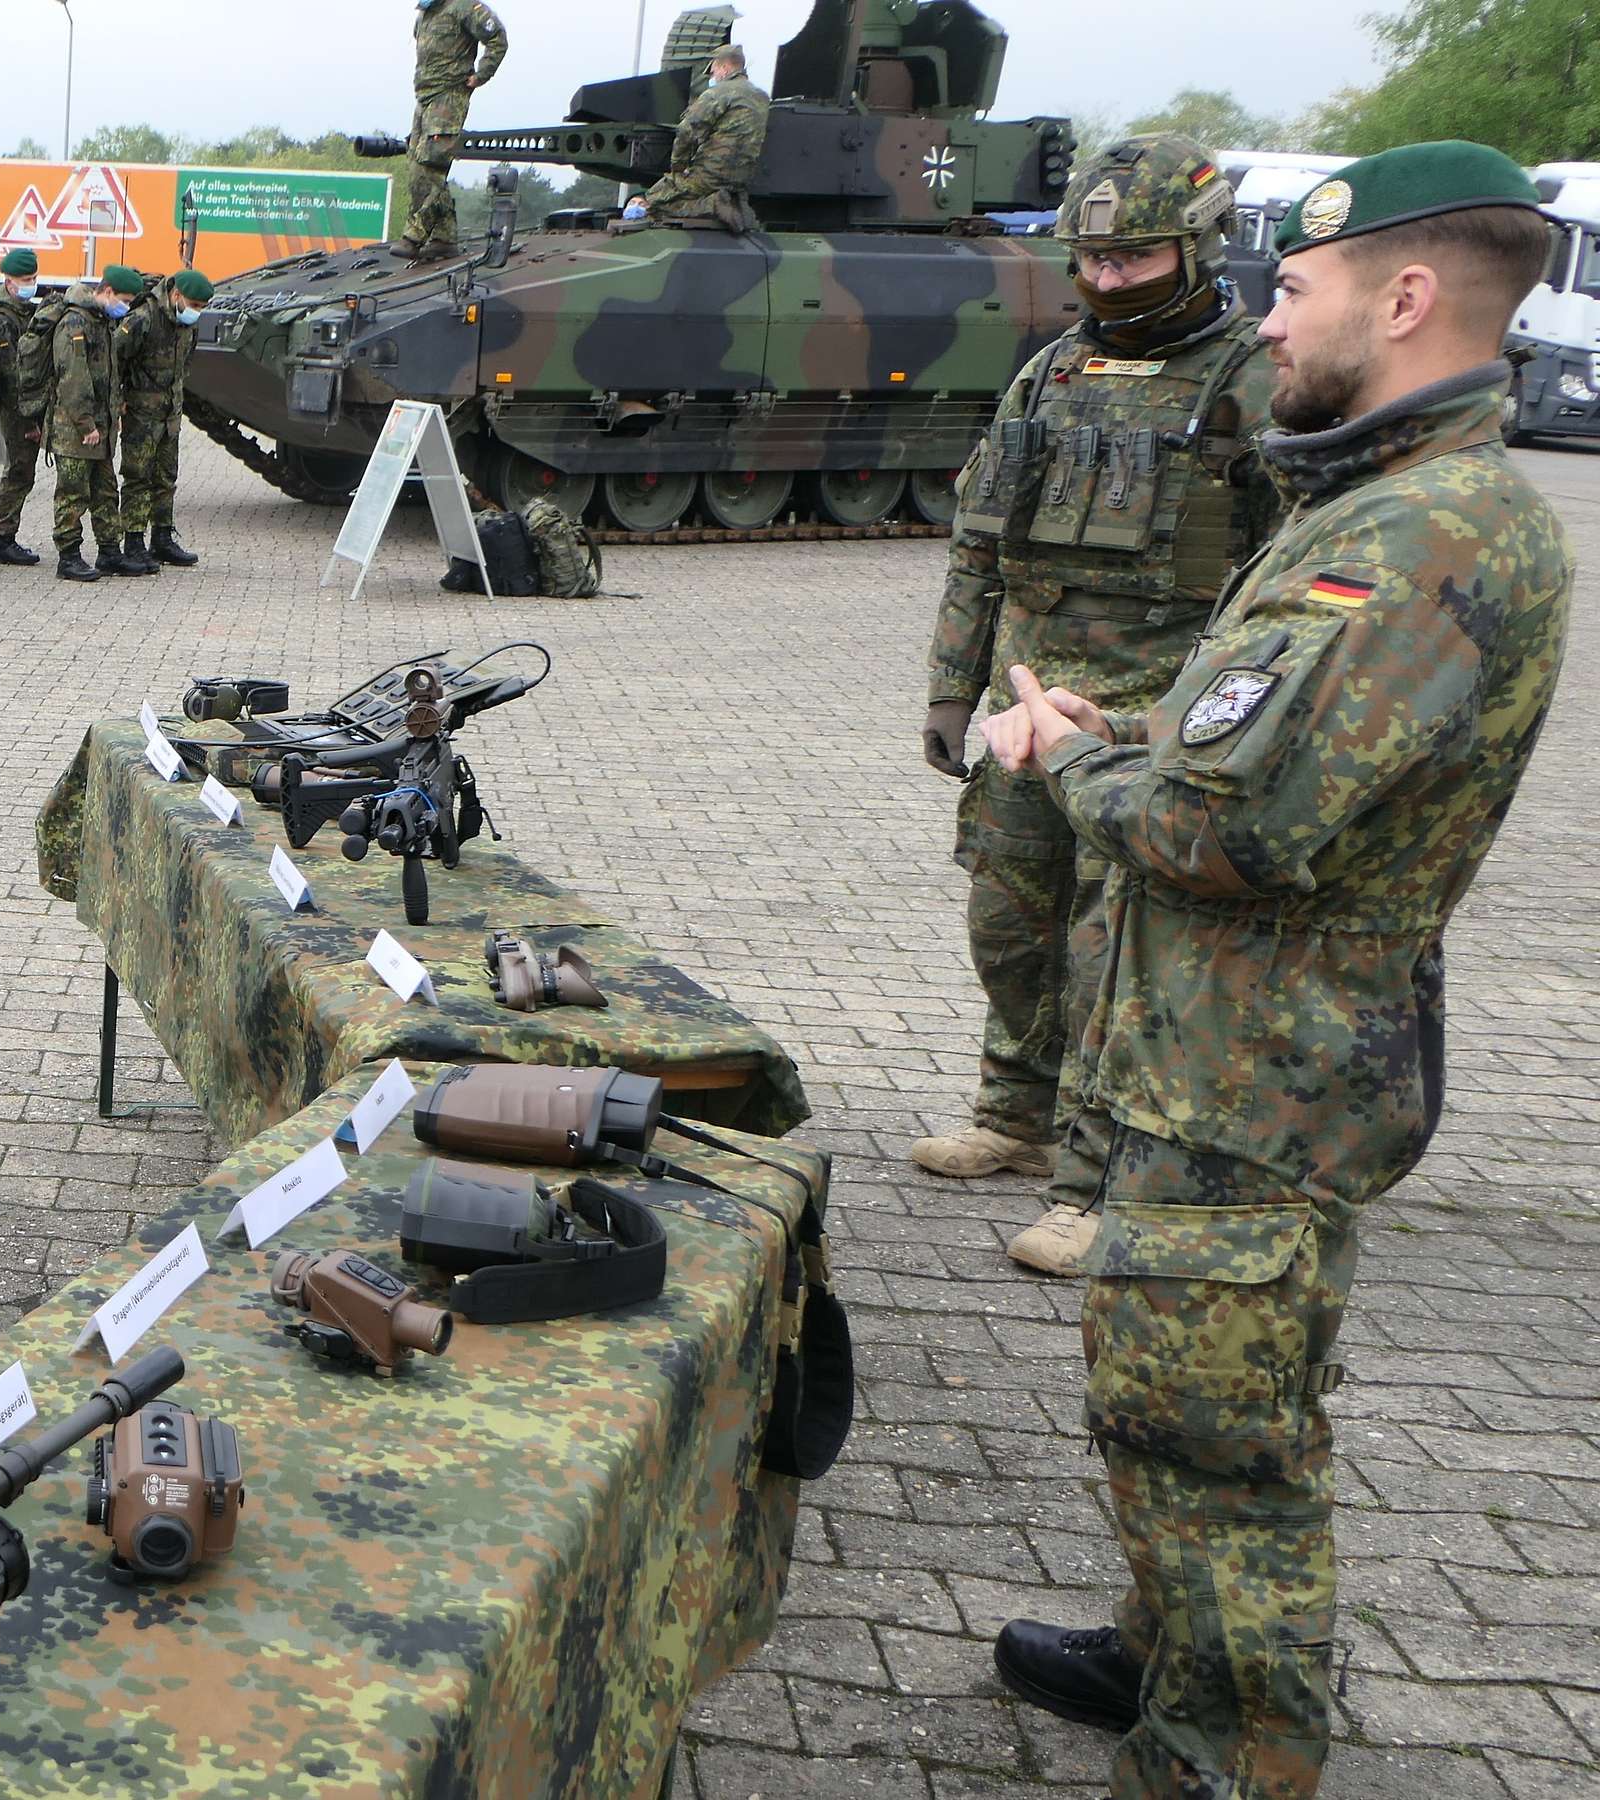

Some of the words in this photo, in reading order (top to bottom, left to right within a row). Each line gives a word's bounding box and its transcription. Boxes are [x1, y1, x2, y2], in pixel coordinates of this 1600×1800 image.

[188, 180, 206, 190] Auf
[208, 181, 231, 191] alles
[206, 193, 228, 205] dem
[230, 194, 270, 208] Training
[273, 195, 290, 206] der
[292, 196, 326, 208] DEKRA
[329, 198, 383, 211] Akademie.
[281, 1175, 302, 1193] Moskito
[112, 1302, 133, 1325] Dragon
